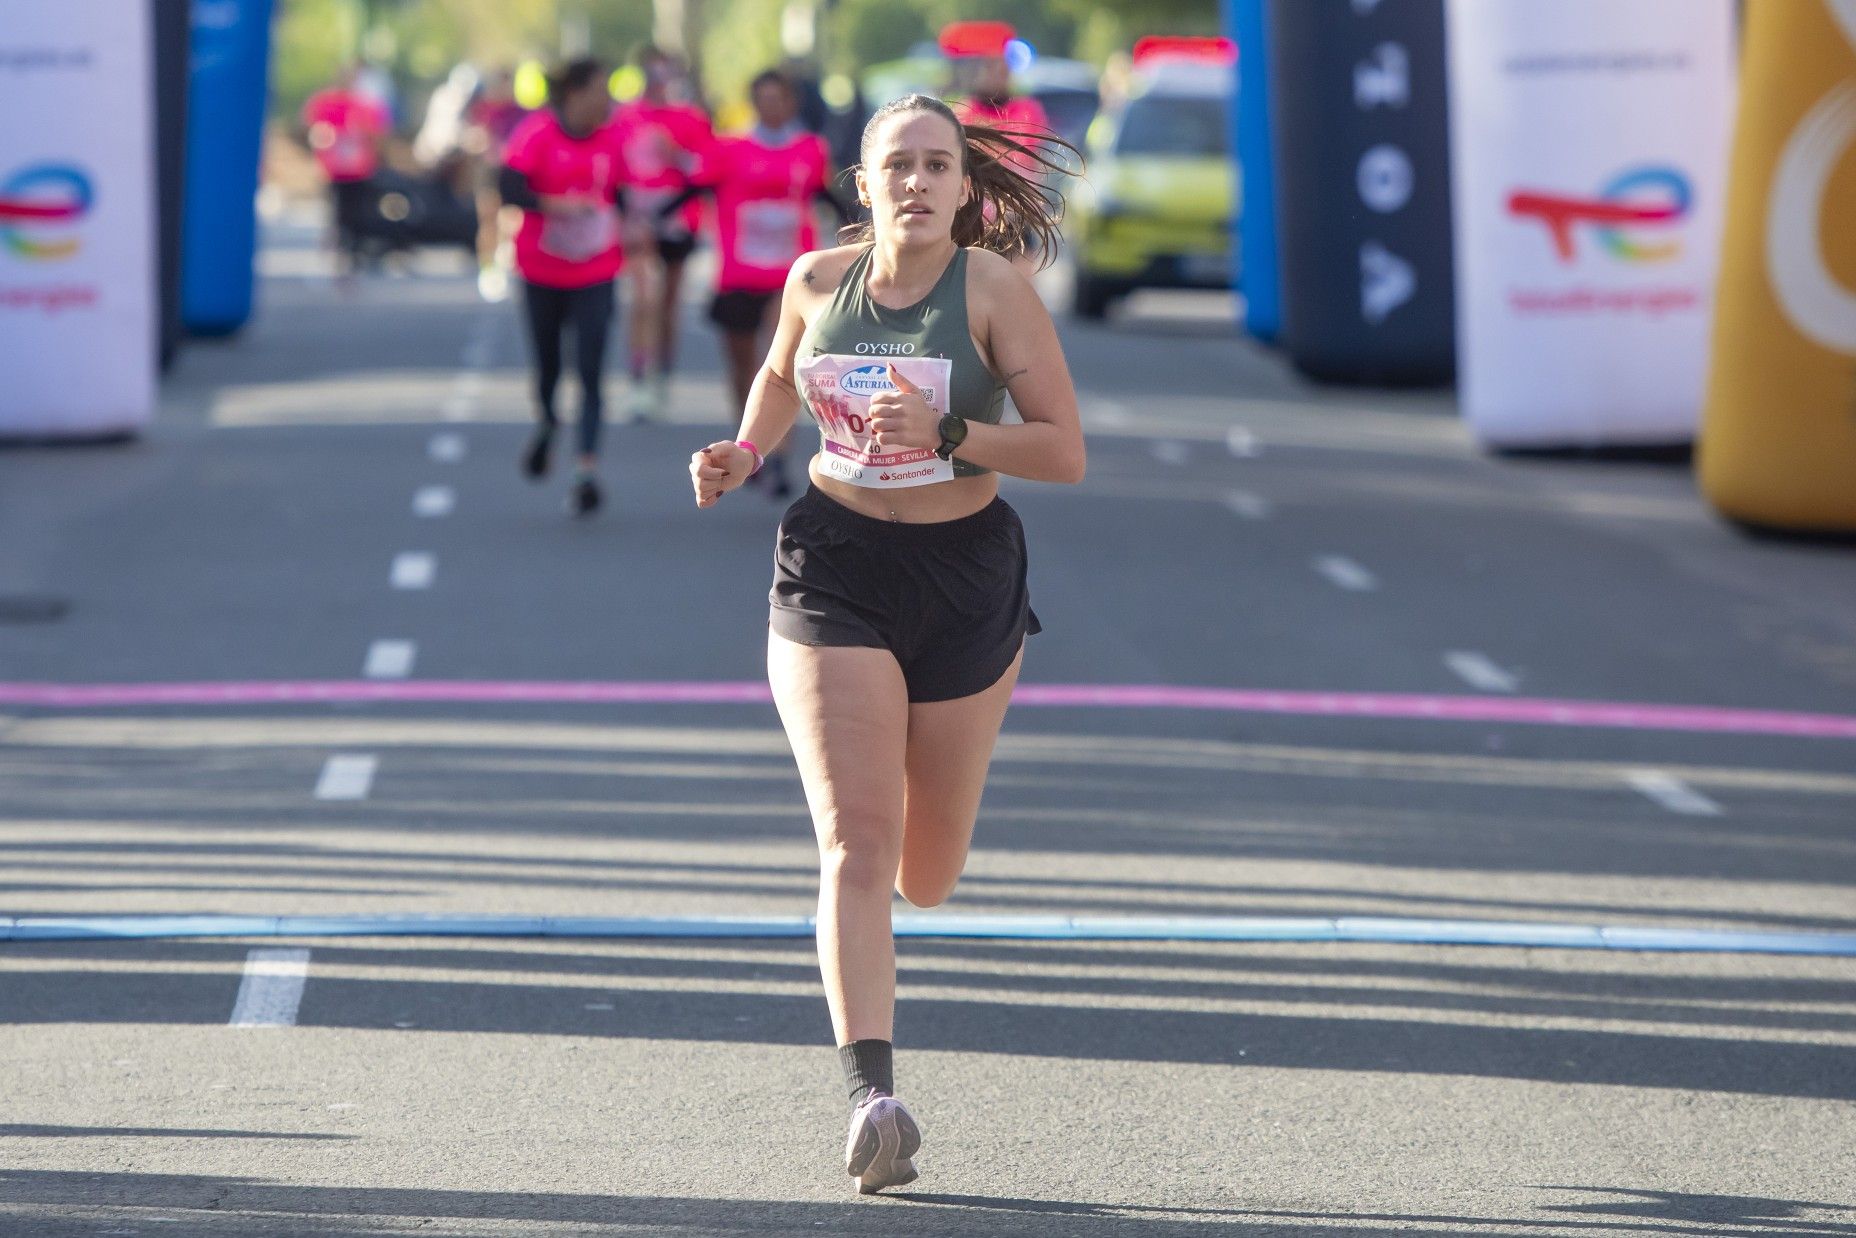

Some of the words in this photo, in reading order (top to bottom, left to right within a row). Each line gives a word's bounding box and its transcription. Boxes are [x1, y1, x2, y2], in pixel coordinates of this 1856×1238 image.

[1351, 0, 1416, 323] VOL
[855, 342, 915, 355] OYSHO
[809, 379, 836, 388] SUMA
[872, 454, 896, 465] MUJER
[901, 450, 929, 463] SEVILLA
[831, 459, 863, 479] OYSHO
[891, 467, 935, 481] Santander
